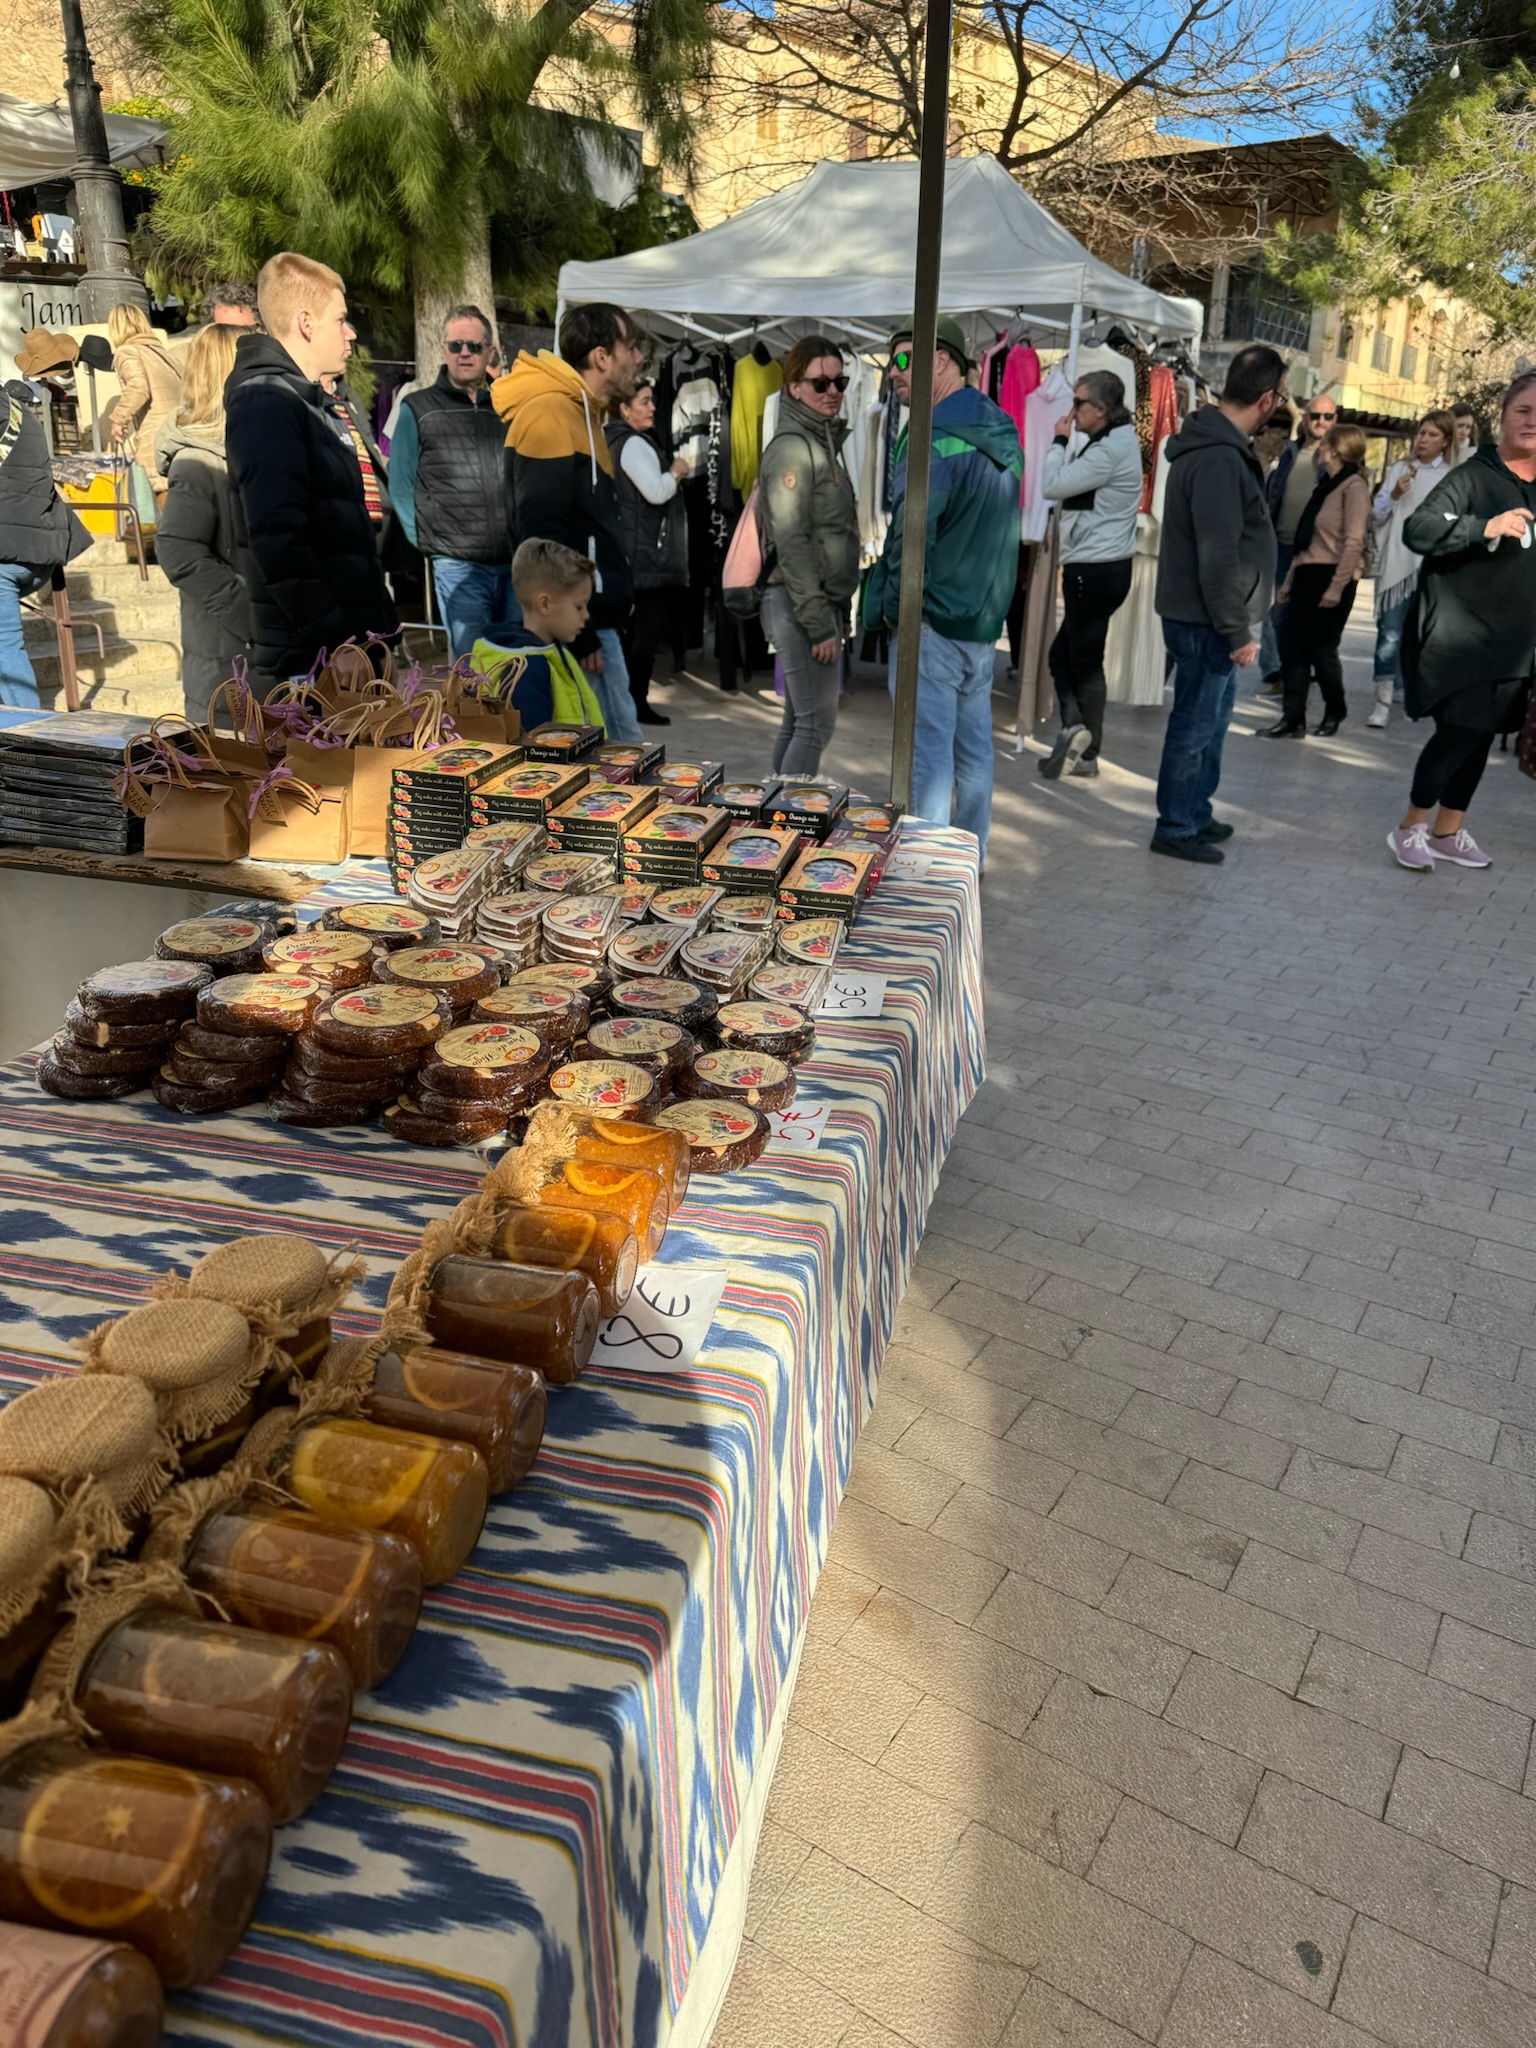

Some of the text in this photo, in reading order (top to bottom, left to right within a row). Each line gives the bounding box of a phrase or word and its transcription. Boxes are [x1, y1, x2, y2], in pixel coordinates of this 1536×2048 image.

[20, 292, 83, 334] Jam
[529, 747, 548, 758] Orange
[415, 776, 423, 784] Fig
[116, 782, 146, 814] PSION
[129, 782, 148, 807] WEET
[491, 799, 499, 807] Fig
[788, 814, 819, 823] Orange cake
[506, 1035, 527, 1047] Pan
[472, 1052, 494, 1067] Higo
